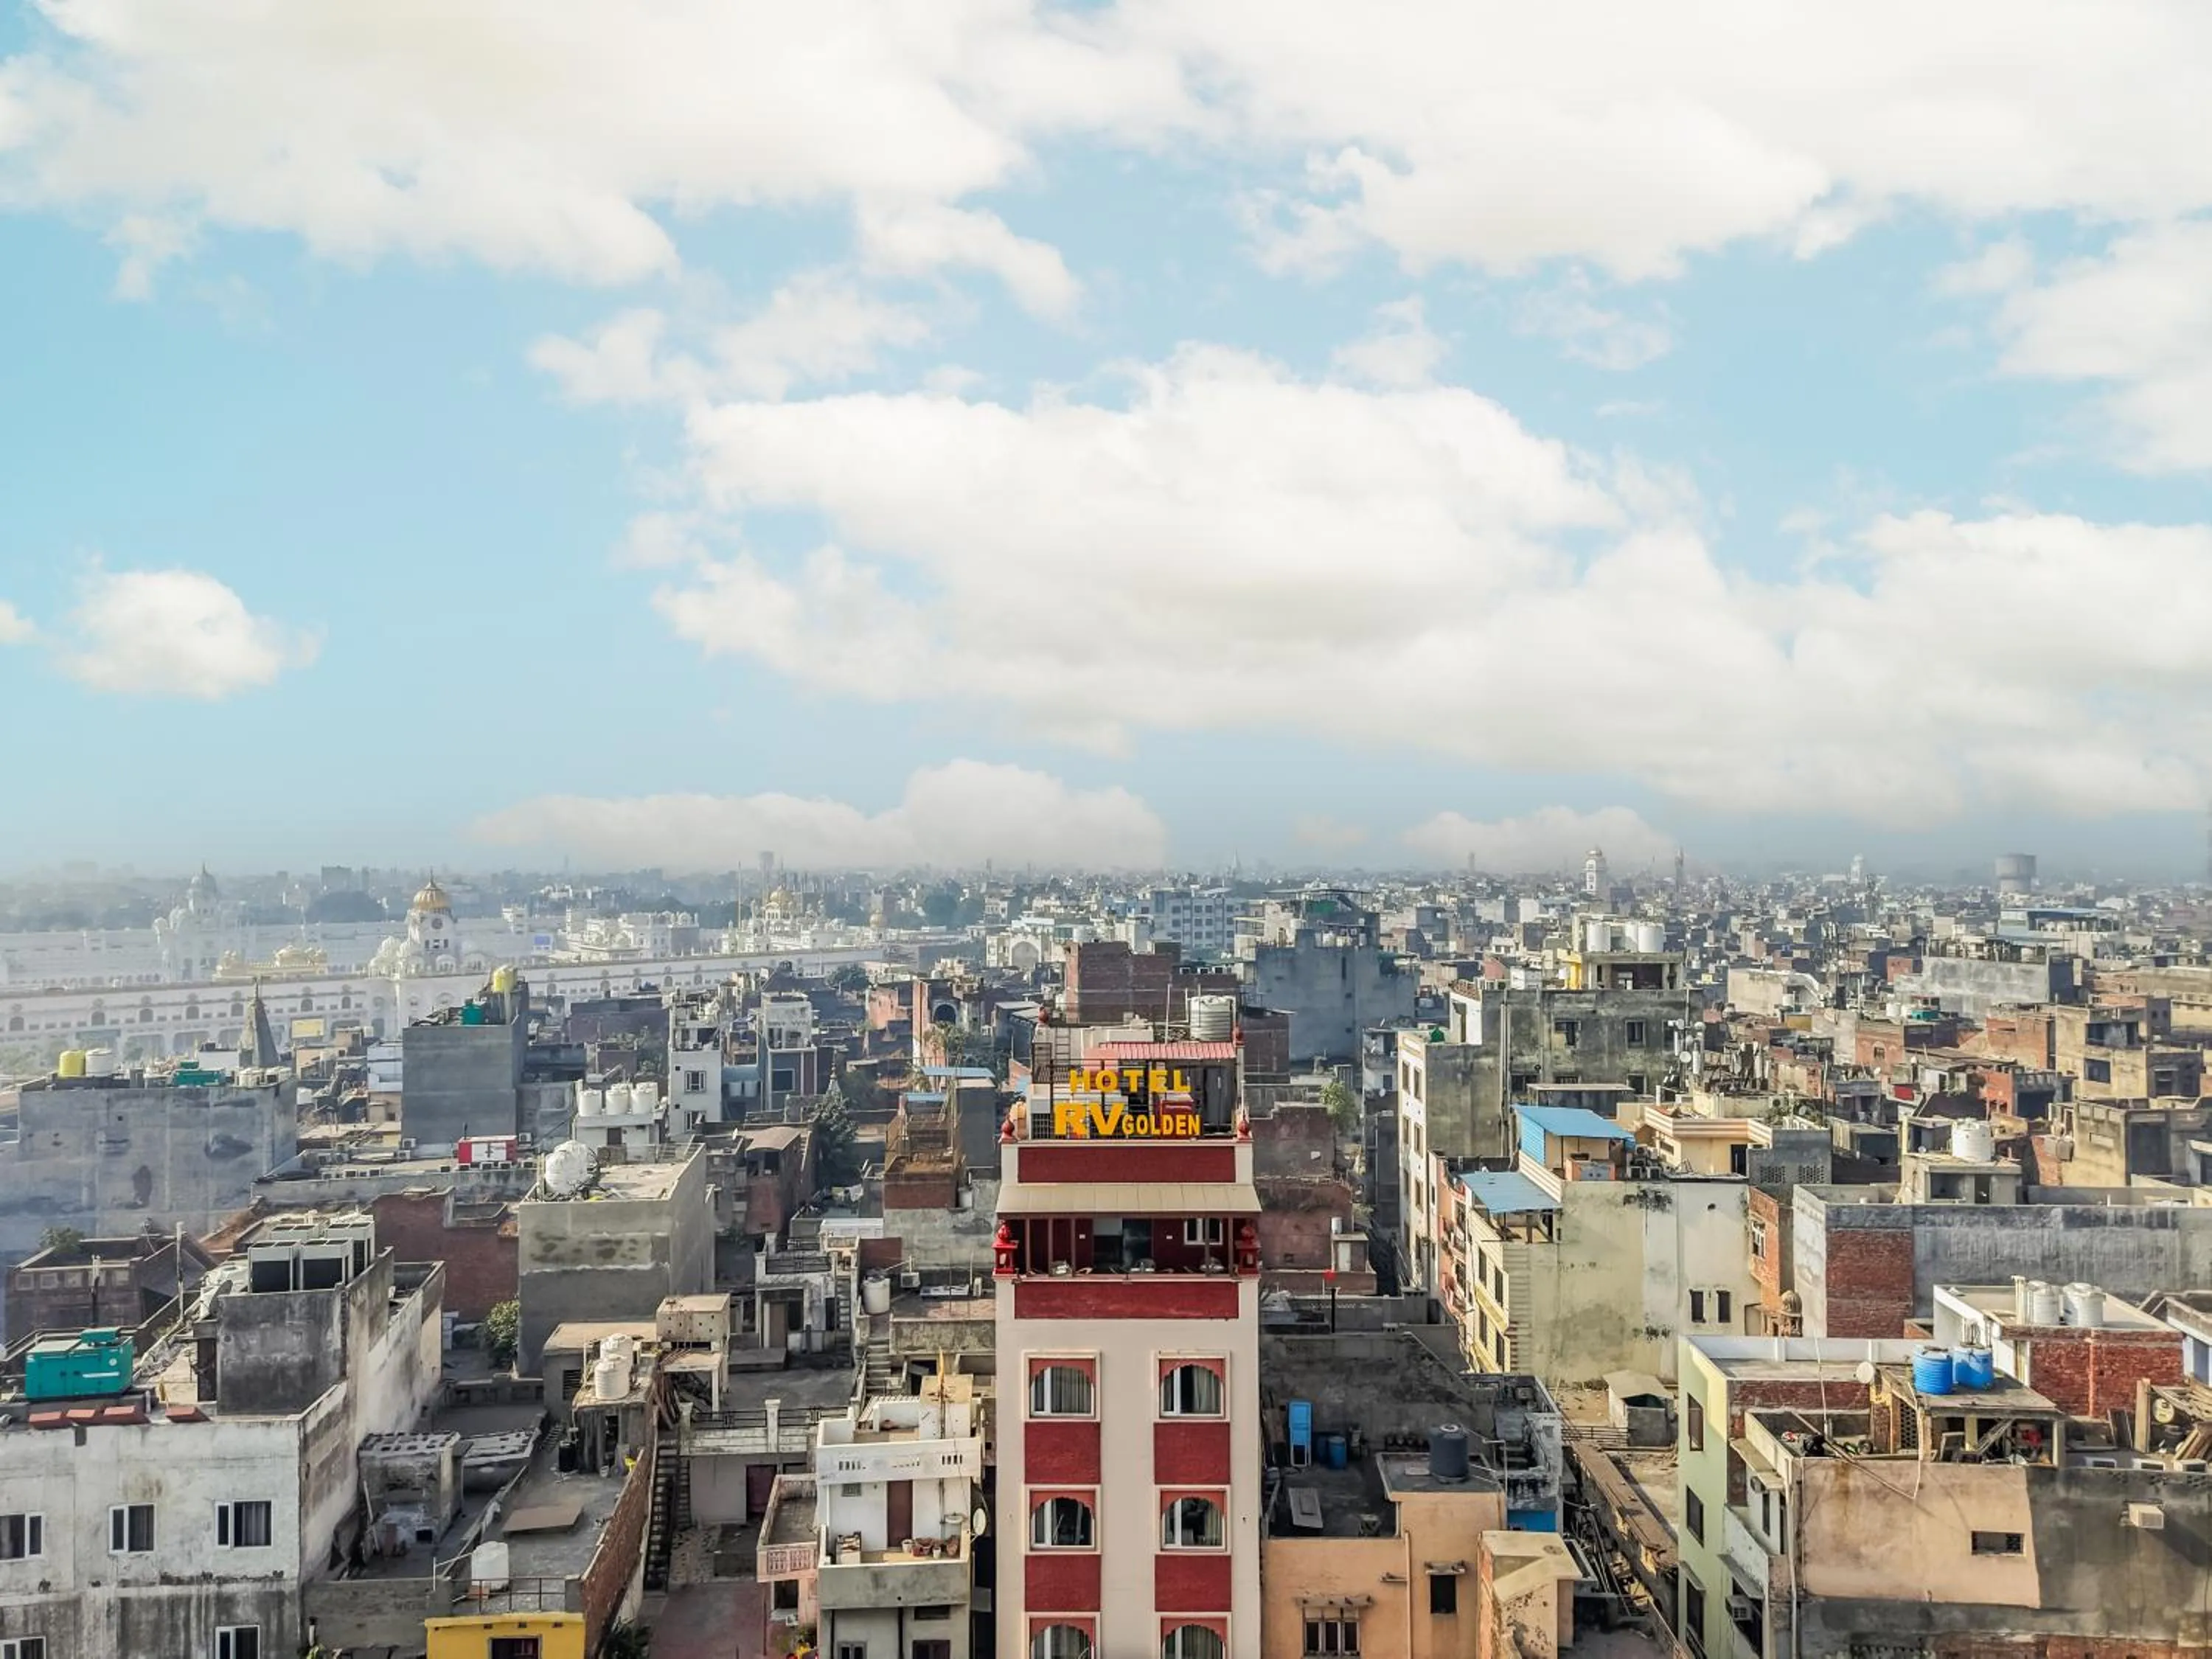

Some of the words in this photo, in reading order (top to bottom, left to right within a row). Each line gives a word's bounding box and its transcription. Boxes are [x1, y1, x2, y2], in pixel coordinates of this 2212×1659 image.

[1069, 1069, 1191, 1093] HOTEL
[1054, 1103, 1124, 1135] RV
[1122, 1114, 1200, 1135] GOLDEN
